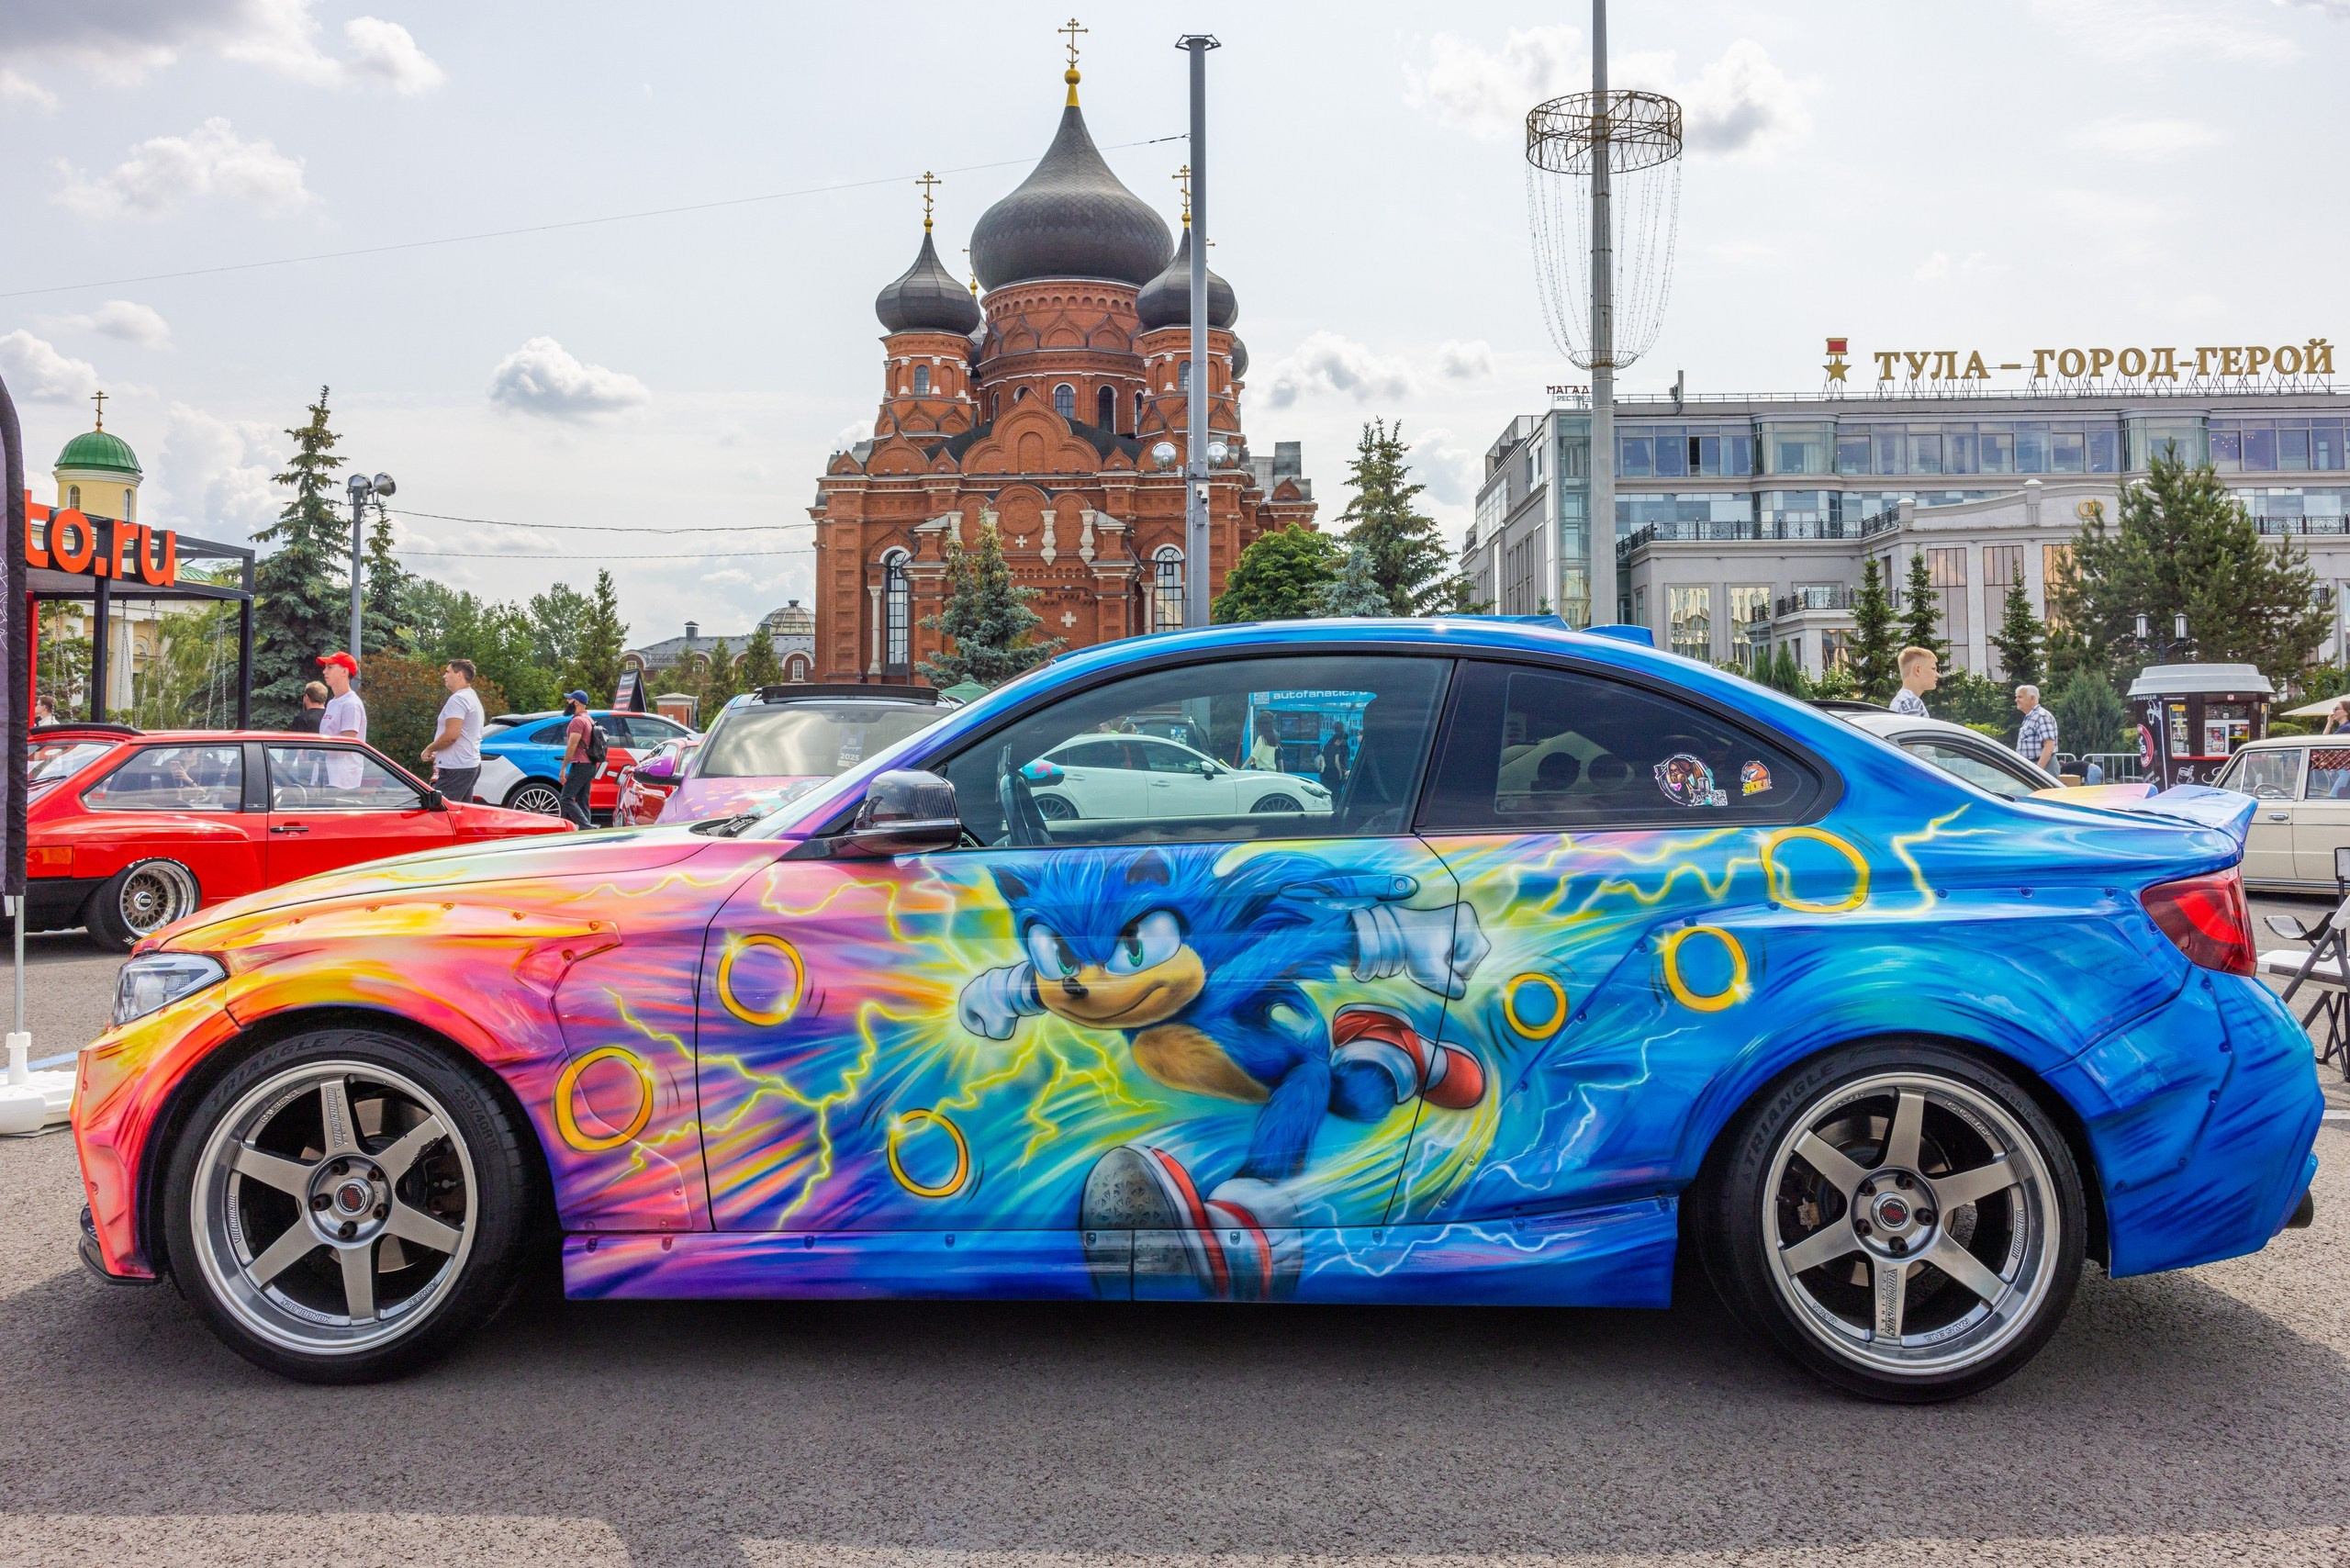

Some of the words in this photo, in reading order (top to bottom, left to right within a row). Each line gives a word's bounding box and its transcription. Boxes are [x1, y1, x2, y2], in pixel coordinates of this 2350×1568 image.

[1874, 350, 1991, 381] ТУЛА
[2033, 338, 2335, 382] ГОРОД-ГЕРОЙ
[1546, 385, 1593, 395] МАГАД
[25, 489, 176, 587] to.ru
[839, 753, 860, 761] 2025
[211, 1036, 330, 1107] TRIANGLE
[1743, 1060, 1836, 1167] TRIANGLE
